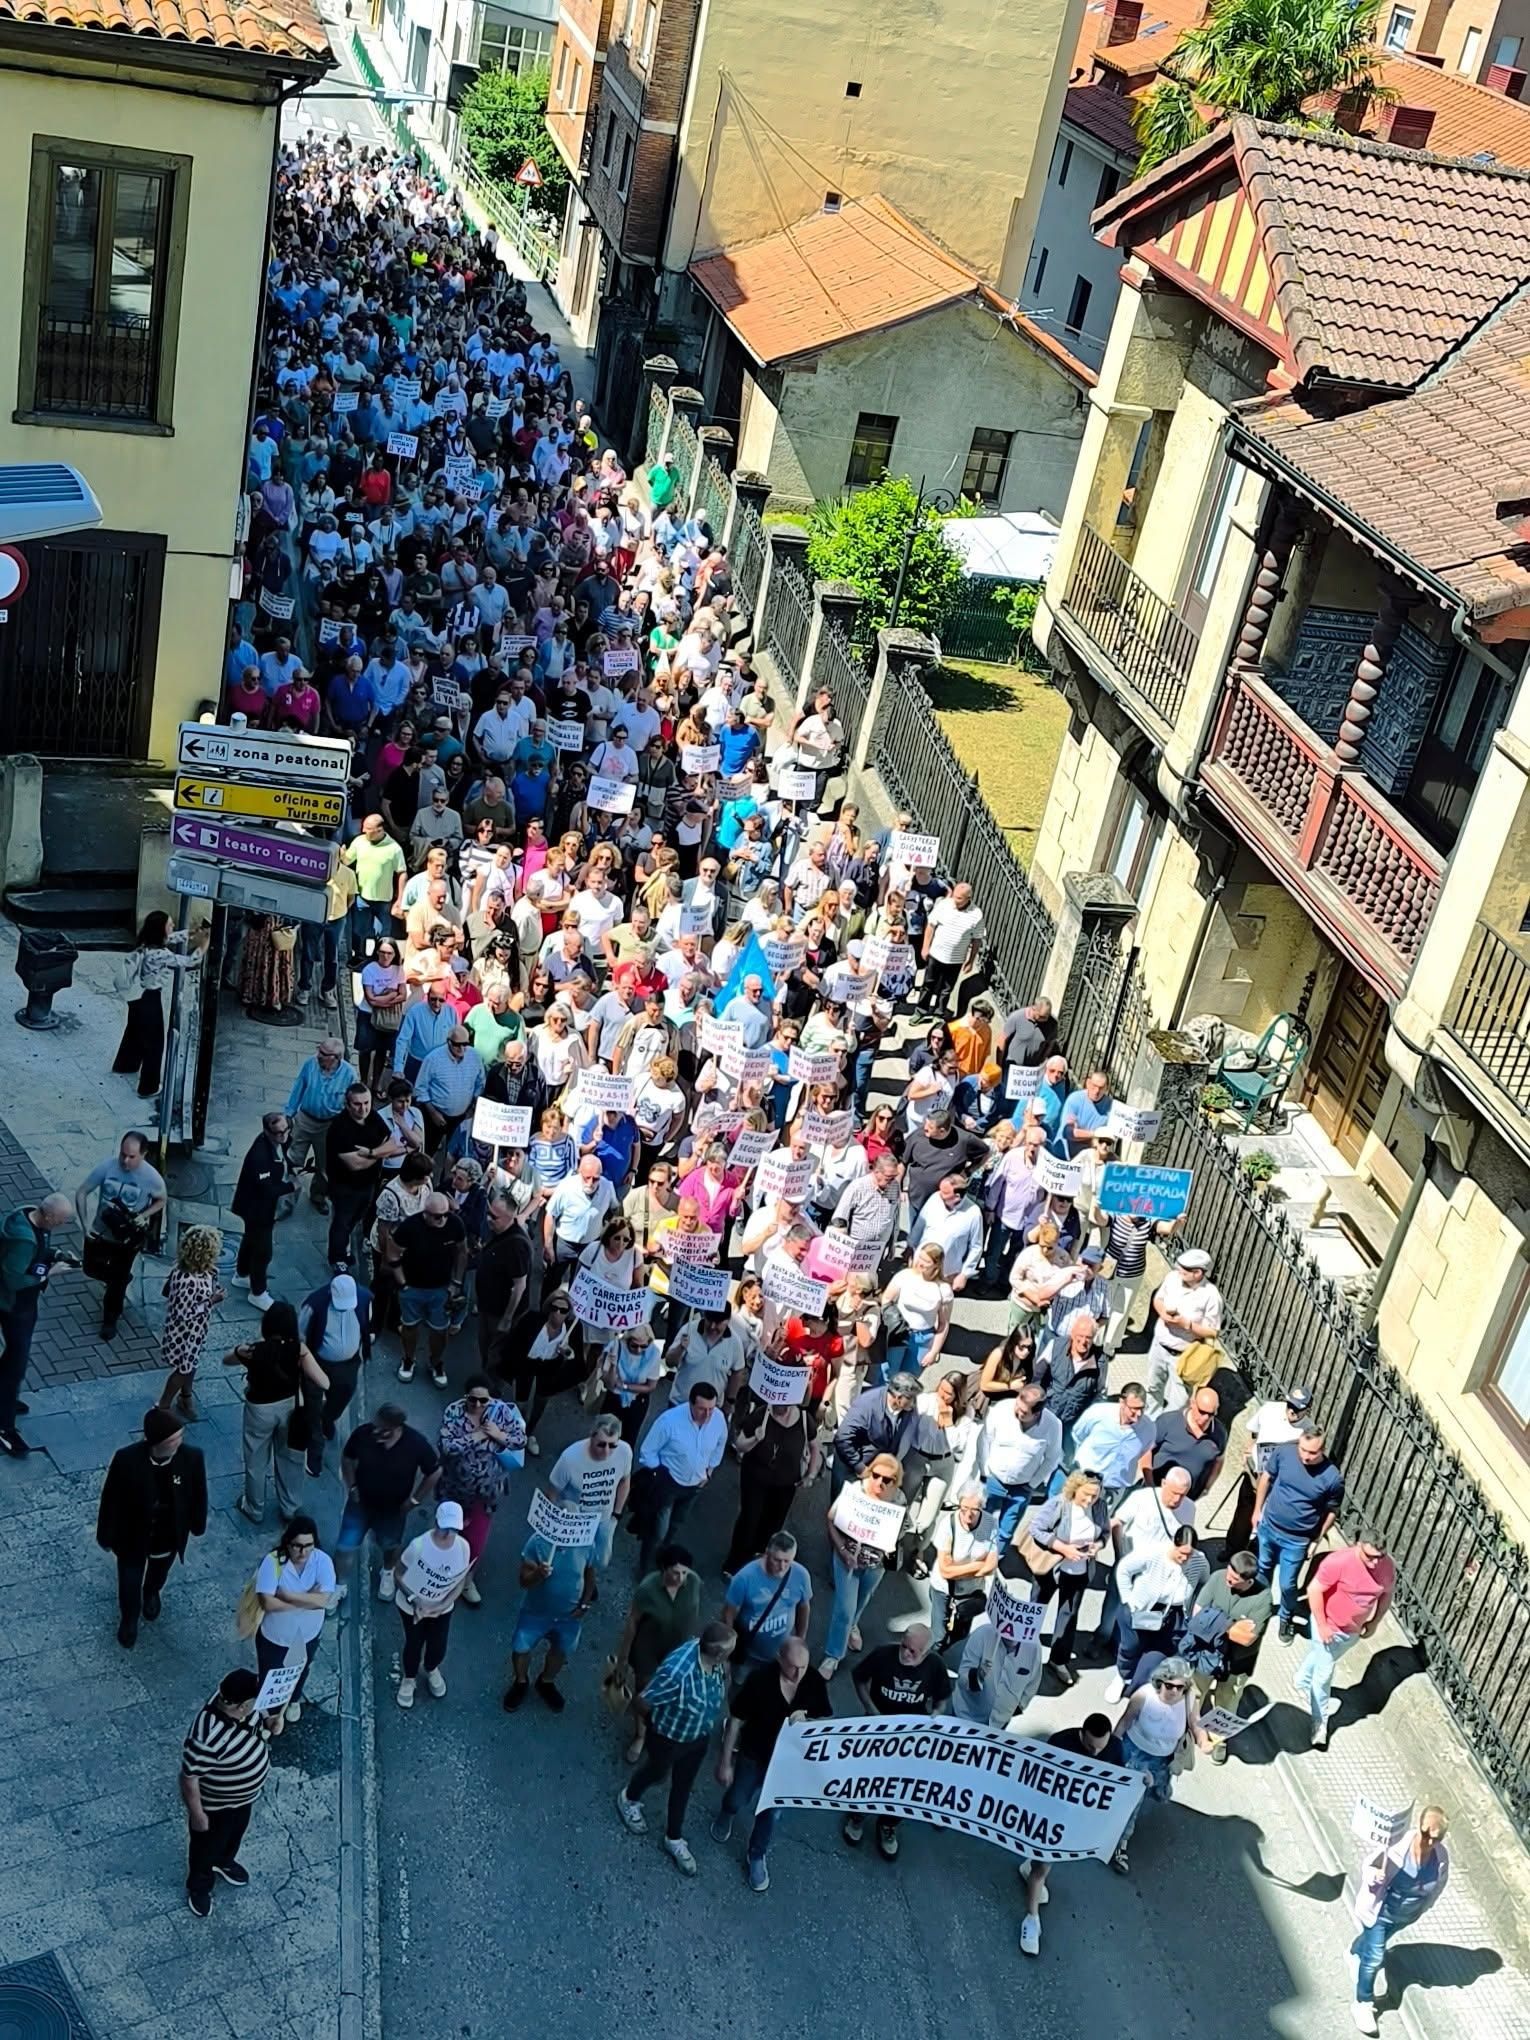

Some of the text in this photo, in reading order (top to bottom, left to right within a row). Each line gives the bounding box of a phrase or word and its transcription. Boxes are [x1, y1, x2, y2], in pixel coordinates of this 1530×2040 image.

[233, 748, 344, 770] zona peatonal
[273, 793, 340, 810] oficina de
[286, 807, 339, 823] Turismo
[224, 835, 327, 871] teatro Toreno
[901, 843, 933, 853] DIGNAS
[909, 852, 922, 863] YA
[763, 1169, 776, 1179] NO
[1111, 1164, 1181, 1182] LA ESPINA
[1105, 1180, 1186, 1199] PONFERRADA
[828, 1244, 875, 1260] NO PUEDE
[825, 1253, 872, 1270] ESPERAR
[592, 1286, 647, 1303] CARRETERAS
[673, 1276, 689, 1290] A-63
[698, 1286, 723, 1298] AS-15
[594, 1298, 641, 1312] DIGNAS
[795, 1290, 821, 1304] AS-15
[606, 1311, 629, 1327] YA
[762, 1360, 809, 1378] SUROCCIDENTE
[759, 1385, 789, 1401] EXISTE
[560, 1528, 591, 1536] AS-15
[847, 1520, 878, 1541] EXISTE
[417, 1559, 425, 1570] EL
[994, 1577, 1043, 1616] CARRETERAS
[992, 1591, 1034, 1626] DIGNAS
[996, 1613, 1015, 1637] YA
[880, 1685, 925, 1704] SUPRA
[1211, 1717, 1229, 1728] NO
[804, 1737, 1116, 1810] EL SUROCCIDENTE MERECE
[823, 1776, 1066, 1846] CARRETERAS DIGNAS
